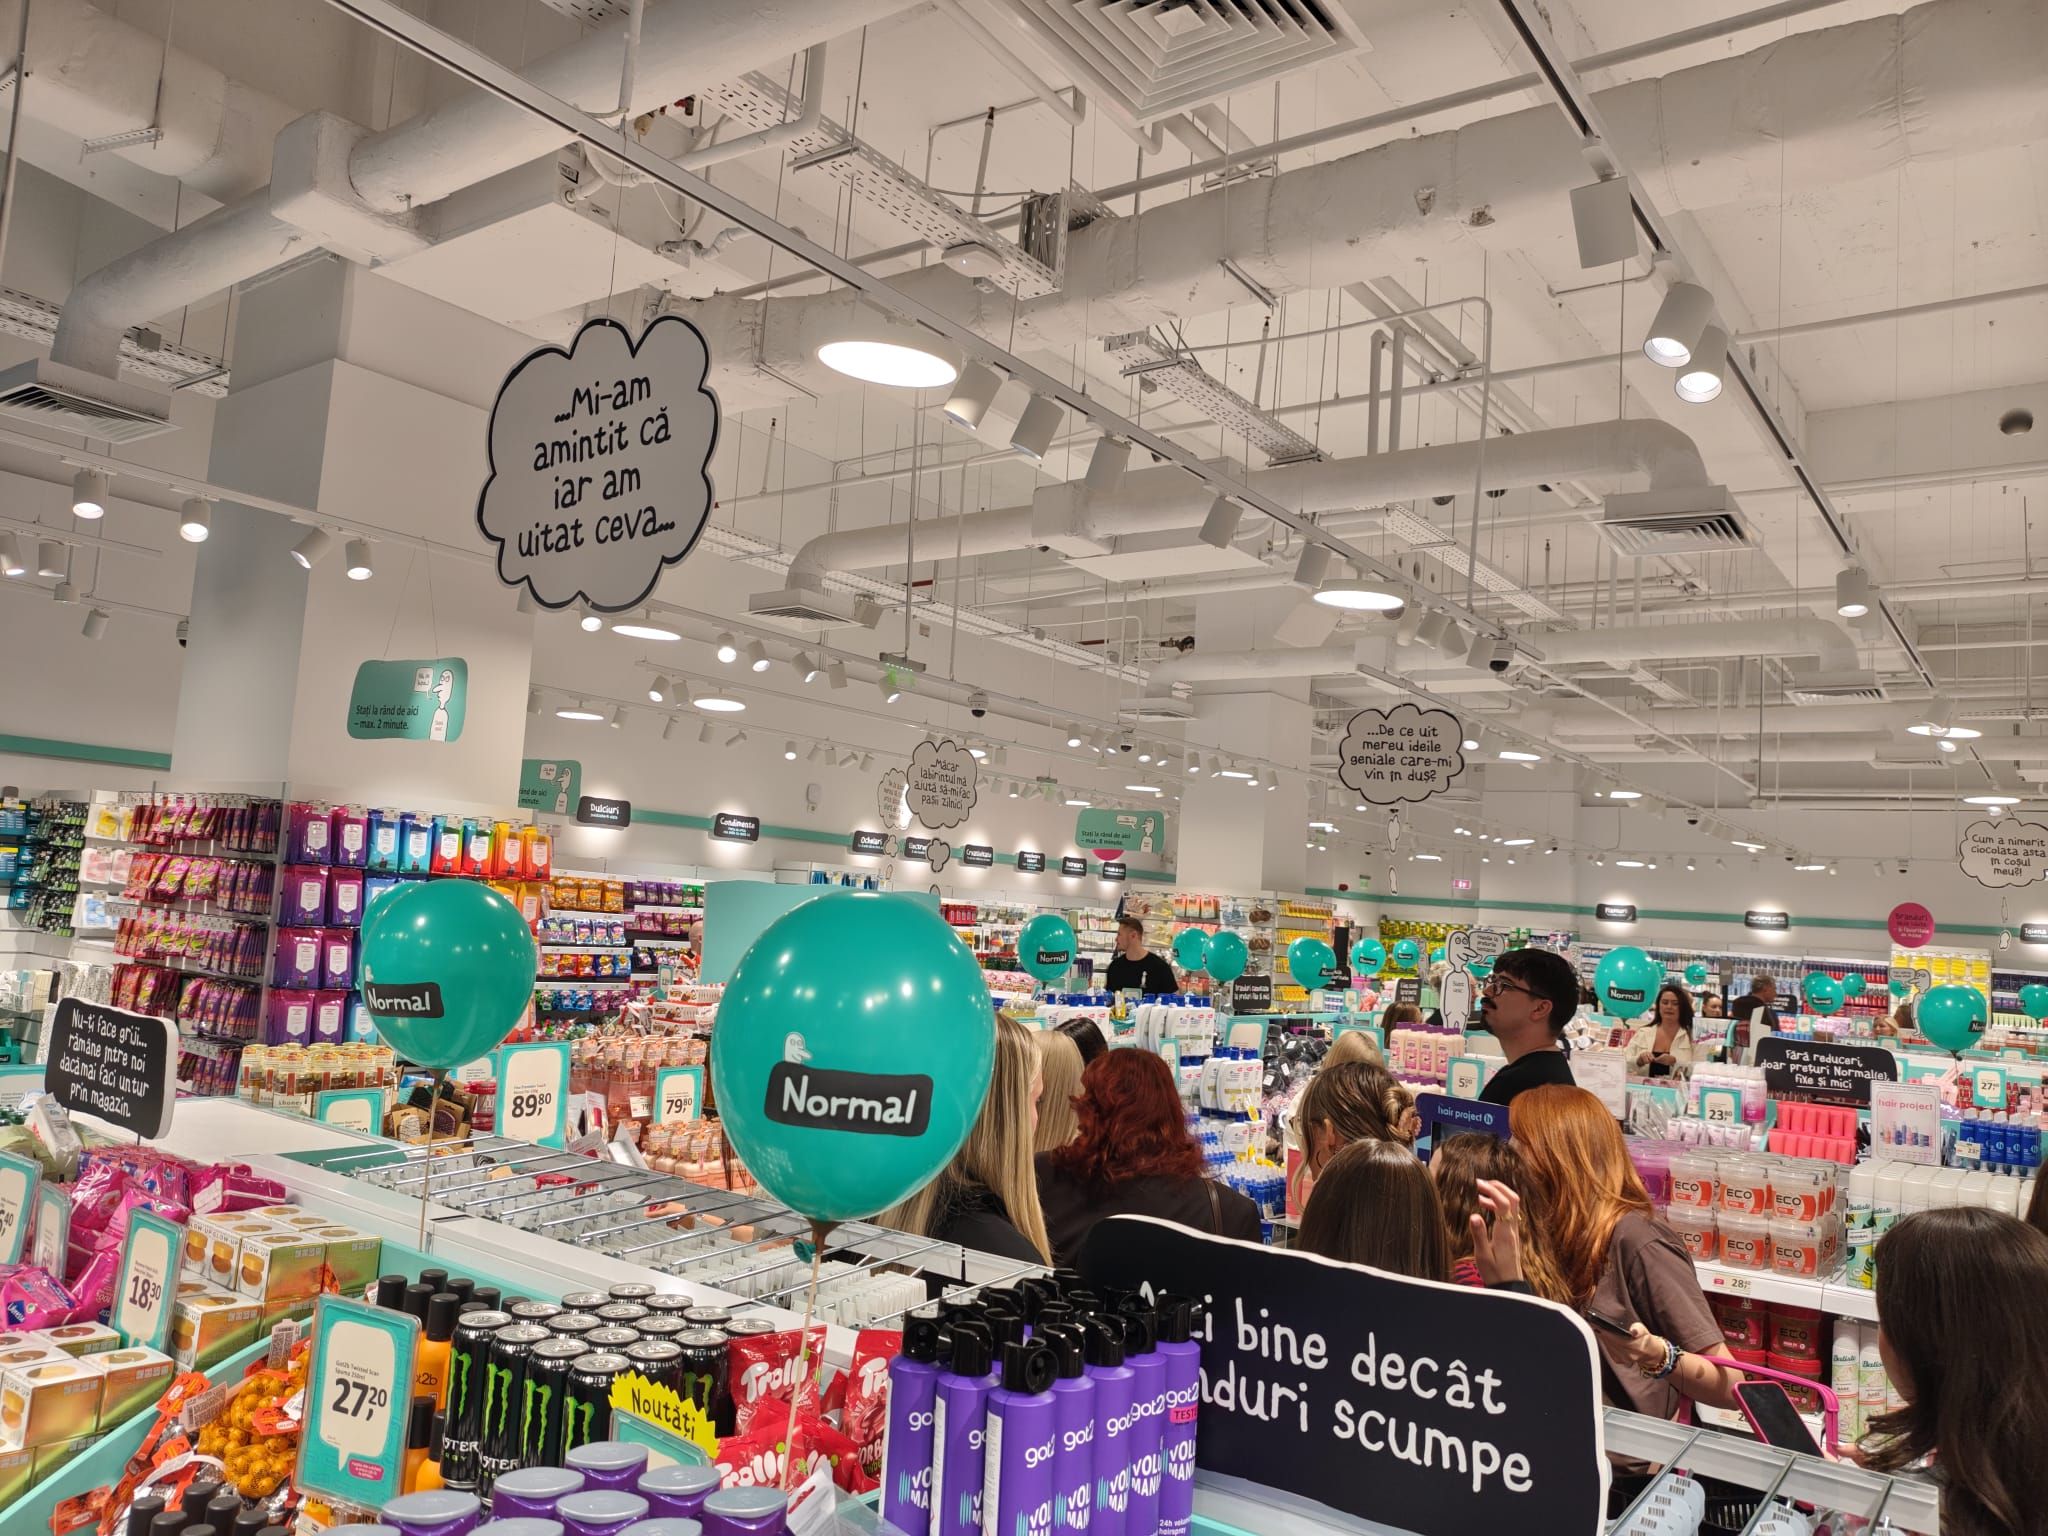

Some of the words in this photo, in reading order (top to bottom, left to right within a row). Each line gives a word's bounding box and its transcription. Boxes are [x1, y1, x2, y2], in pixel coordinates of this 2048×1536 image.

[533, 420, 629, 471] amintit
[640, 406, 672, 446] că
[554, 475, 592, 510] iar
[602, 467, 641, 500] am
[518, 518, 585, 557] uitat
[356, 705, 372, 716] Stați
[373, 705, 379, 715] la
[379, 705, 395, 715] rând
[396, 705, 406, 716] de
[406, 706, 419, 716] aici
[377, 720, 382, 729] 2
[383, 720, 409, 730] minute.
[1400, 728, 1414, 737] ce
[1419, 726, 1439, 737] uit
[1362, 740, 1404, 752] mereu
[1409, 740, 1441, 752] ideile
[1350, 753, 1396, 766] geniale
[1400, 756, 1452, 768] care-mi
[920, 767, 956, 785] labirintul
[1364, 768, 1384, 780] vin
[914, 780, 937, 793] ajută
[959, 787, 971, 800] fac
[590, 803, 620, 815] Dulciuri
[941, 798, 963, 811] zilnici
[1972, 833, 1994, 844] Cum
[1998, 837, 2004, 845] a
[2008, 835, 2045, 847] nimerit
[1971, 845, 2019, 856] ciocolata
[2023, 848, 2046, 858] asta
[2004, 856, 2031, 867] coșul
[1993, 866, 2022, 876] meu?!
[1040, 953, 1067, 962] Normal
[368, 988, 431, 1012] Normal
[1610, 989, 1642, 1001] Normal
[72, 1008, 95, 1034] Nu-ți
[97, 1015, 117, 1038] face
[68, 1033, 101, 1057] rămâne
[131, 1053, 146, 1073] noi
[1786, 1050, 1810, 1062] Fără
[1813, 1052, 1863, 1068] reduceri,
[60, 1052, 80, 1075] dacă
[80, 1062, 97, 1081] mai
[98, 1064, 117, 1088] faci
[119, 1074, 131, 1093] un
[132, 1078, 150, 1098] tur
[1760, 1059, 1786, 1070] doar
[1790, 1062, 1830, 1075] prețuri
[1818, 1076, 1827, 1087] și
[1830, 1079, 1852, 1089] mici
[70, 1082, 88, 1103] prin
[91, 1089, 131, 1118] magazin.
[512, 1093, 551, 1118] 89,80
[783, 1075, 917, 1124] Normal
[1878, 1098, 1897, 1109] hair
[1899, 1102, 1933, 1112] project
[1437, 1104, 1453, 1117] hair
[1454, 1110, 1482, 1122] project
[1674, 1180, 1699, 1191] ECO
[1726, 1188, 1753, 1200] ECO
[1776, 1194, 1801, 1206] ECO
[1727, 1239, 1754, 1251] ECO
[1776, 1246, 1802, 1258] ECO
[129, 1275, 162, 1312] 18,30
[1779, 1327, 1808, 1340] ECO
[1235, 1296, 1329, 1371] bine
[1351, 1331, 1508, 1415] decât
[332, 1377, 387, 1421] 27,20
[1166, 1382, 1199, 1408] got2
[631, 1386, 696, 1442] Noutăți
[1131, 1394, 1165, 1421] got2
[1064, 1419, 1094, 1451] got2
[1332, 1398, 1534, 1494] scumpe
